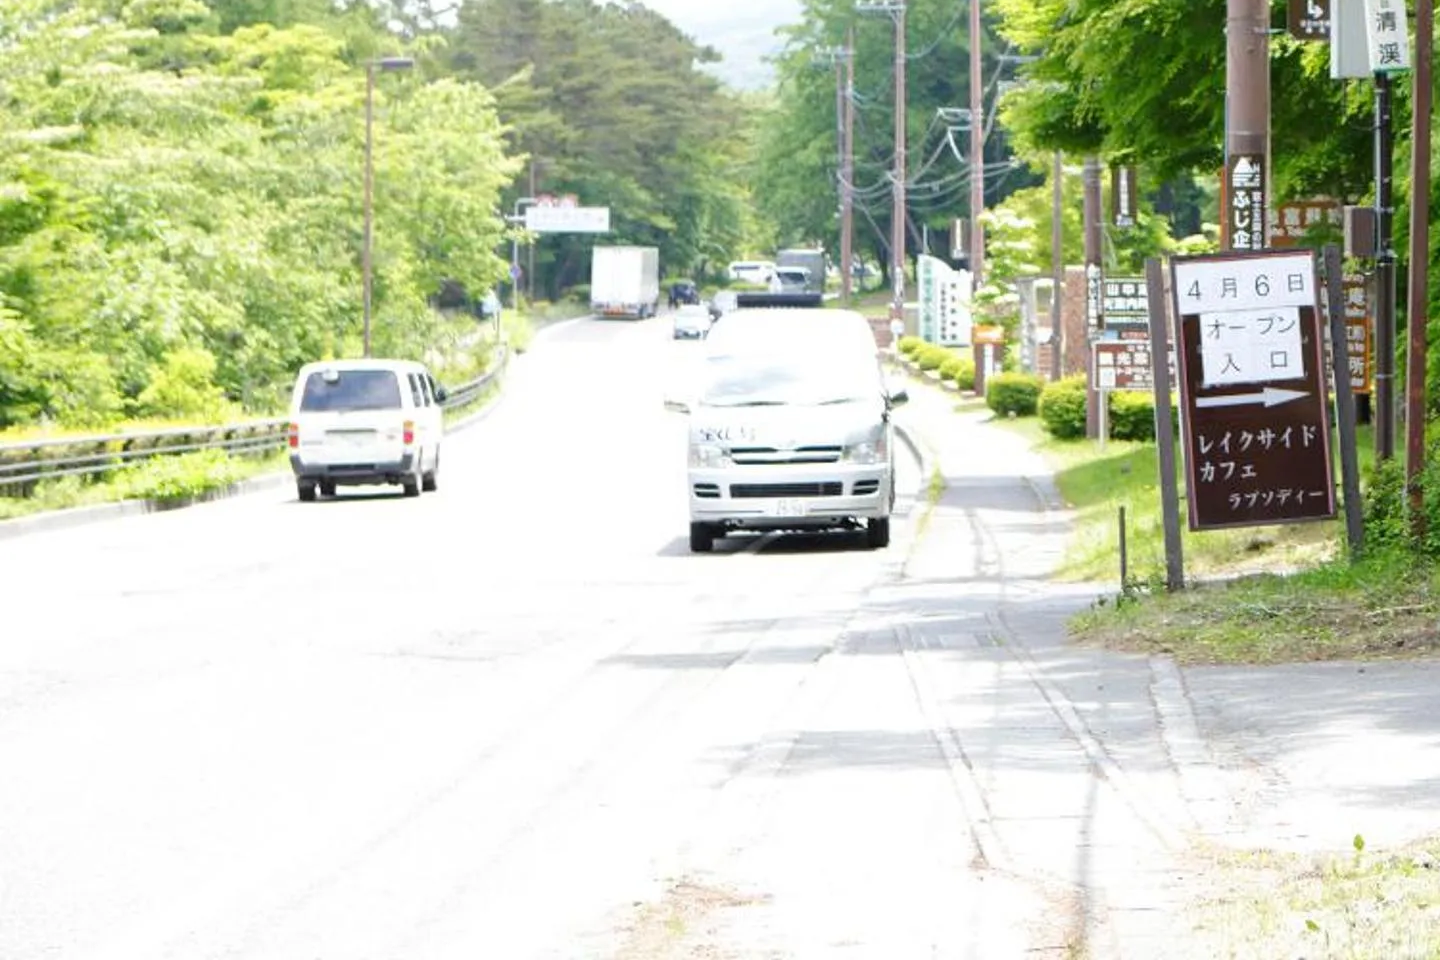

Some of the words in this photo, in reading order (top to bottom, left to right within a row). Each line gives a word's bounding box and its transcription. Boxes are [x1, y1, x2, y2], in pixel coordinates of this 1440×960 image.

[1186, 273, 1305, 301] 4月6日
[1206, 313, 1296, 340] オープン
[1220, 350, 1289, 375] 入口
[1198, 423, 1317, 455] レイクサイド
[1200, 460, 1258, 483] カフェ
